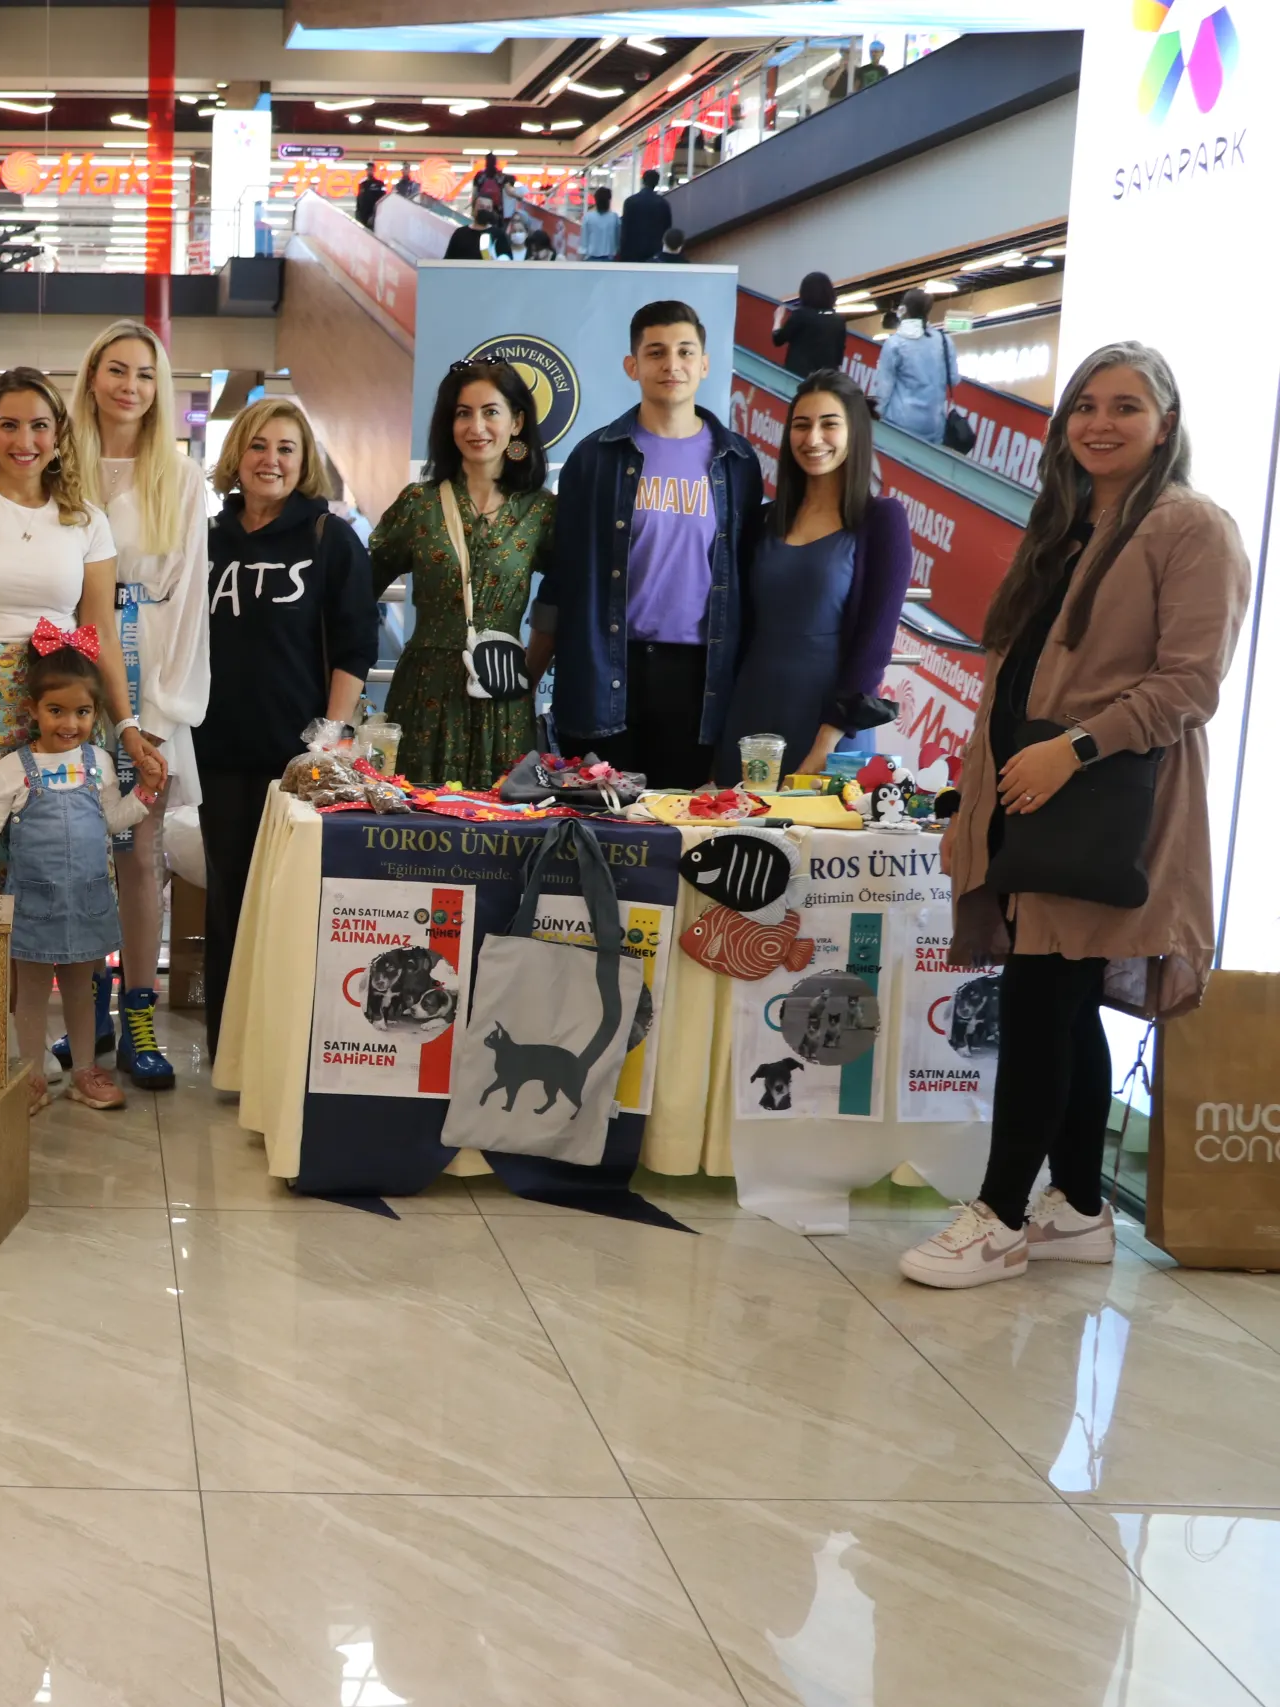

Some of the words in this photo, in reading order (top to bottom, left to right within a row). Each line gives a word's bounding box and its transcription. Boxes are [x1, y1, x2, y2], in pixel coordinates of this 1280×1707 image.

[1113, 128, 1247, 200] SAYAPARK
[636, 476, 709, 517] MAVİ
[210, 559, 313, 617] ATS
[362, 826, 452, 853] TOROS
[804, 891, 854, 908] ğitimin
[858, 888, 925, 903] Ötesinde,
[333, 907, 356, 917] CAN
[358, 908, 410, 919] SATILMAZ
[331, 918, 377, 931] SATIN
[330, 931, 411, 947] ALINAMAZ
[916, 936, 940, 945] CAN
[323, 1041, 360, 1051] SATIN
[362, 1043, 398, 1053] ALMA
[909, 1069, 944, 1079] SATIN
[946, 1070, 980, 1079] ALMA
[1194, 1135, 1280, 1162] con
